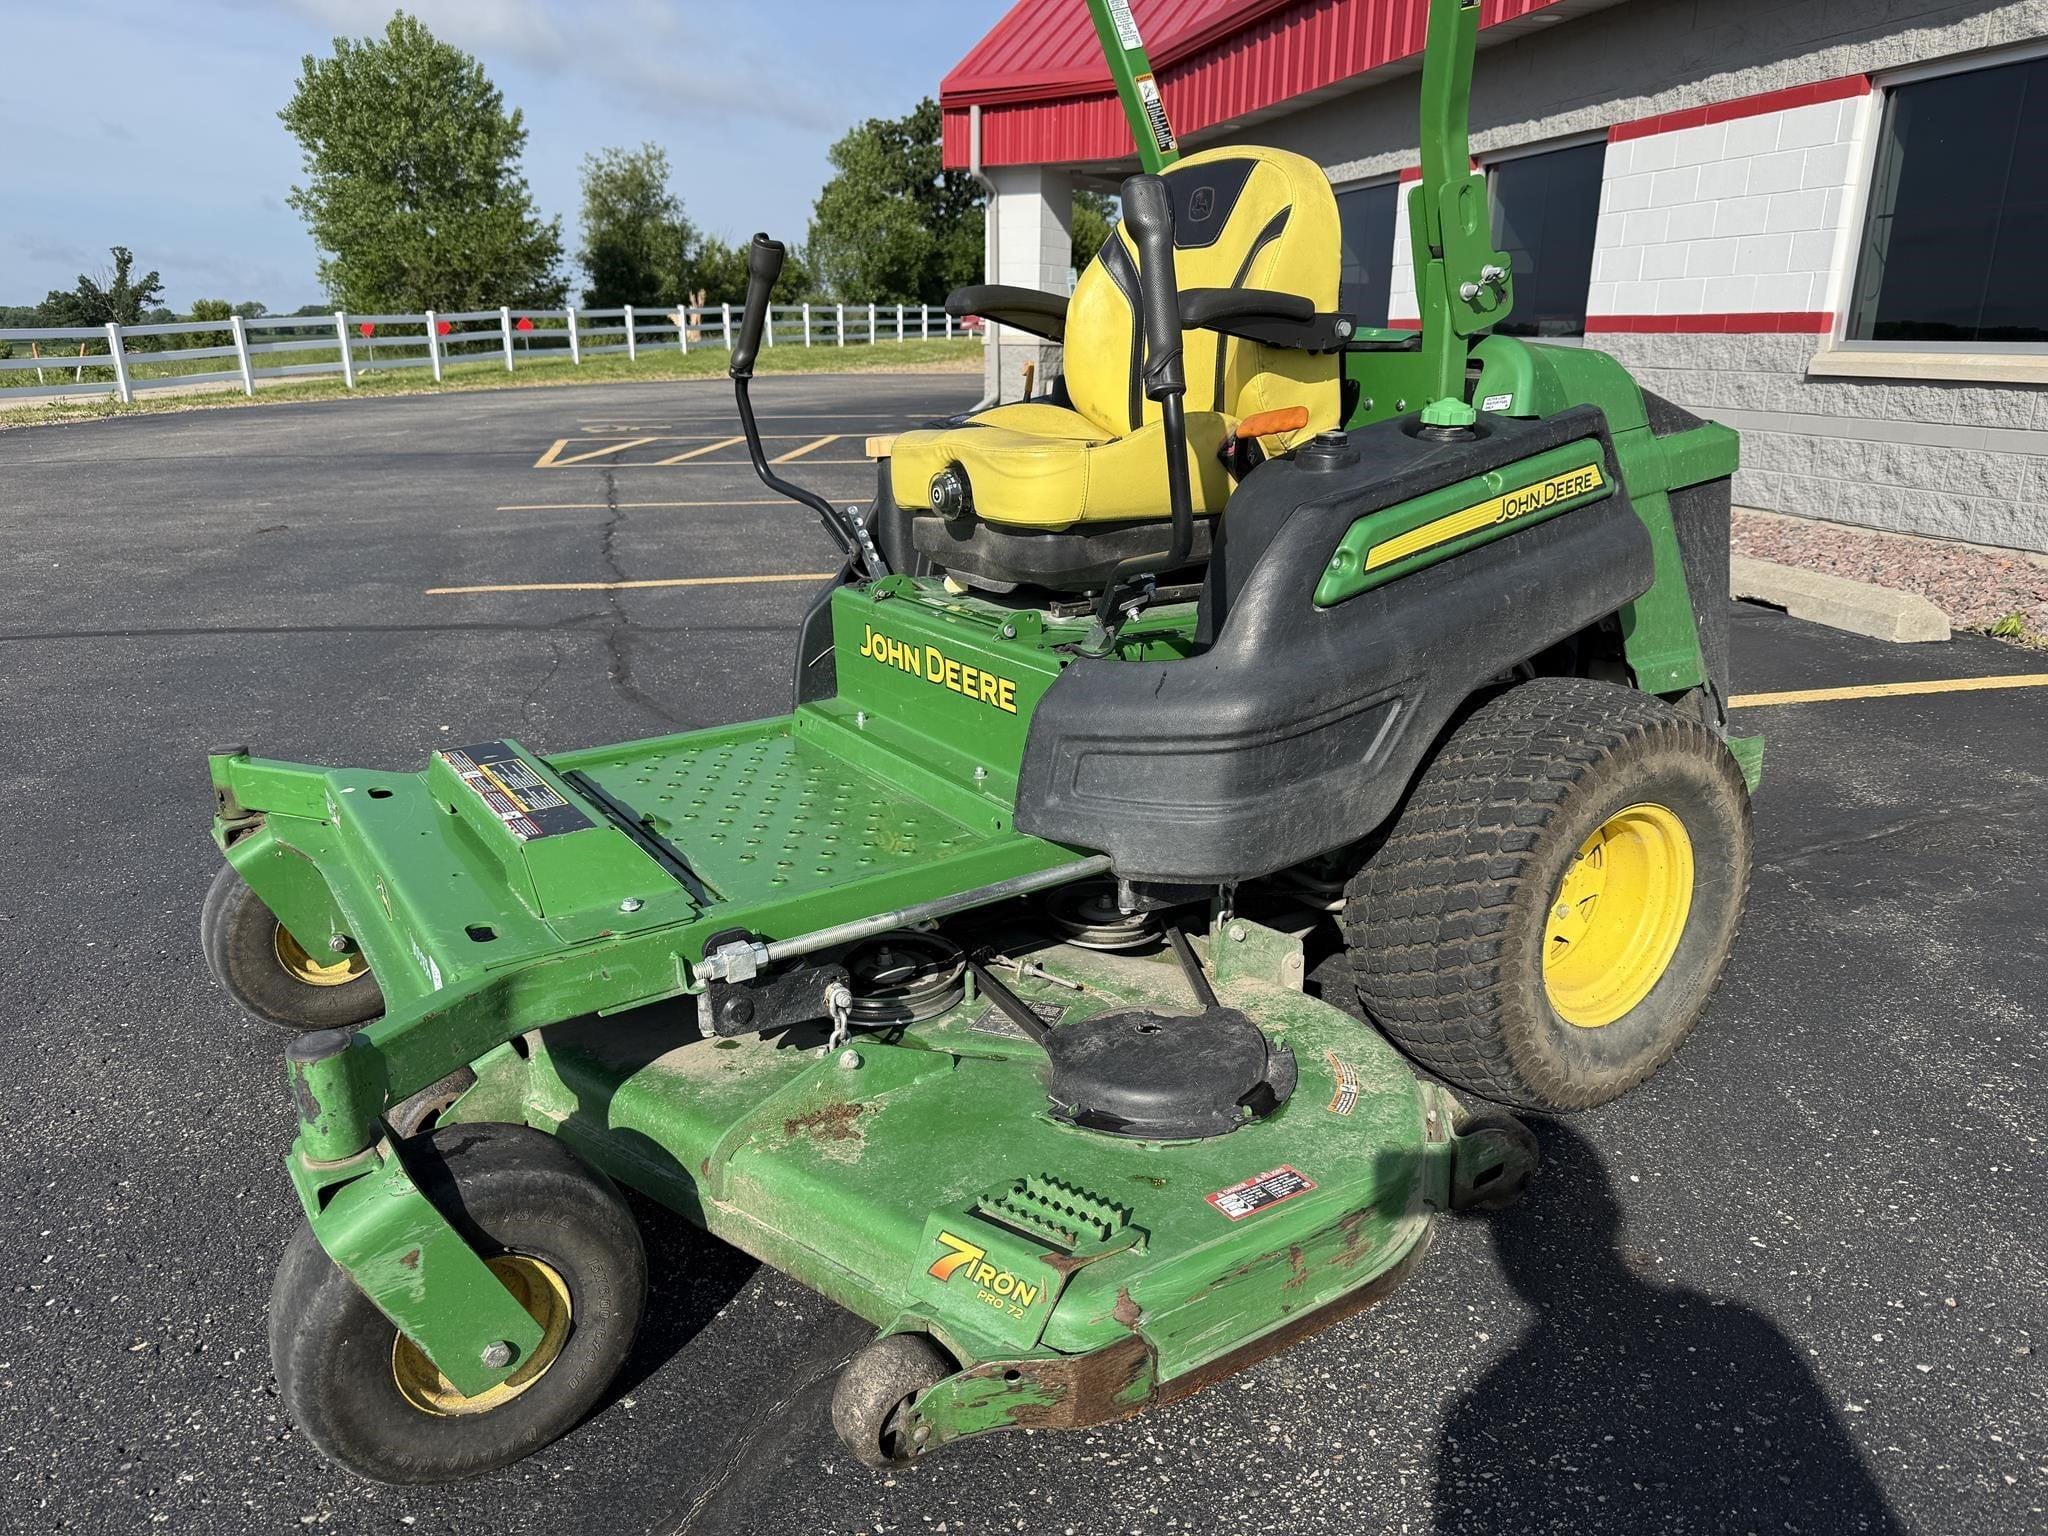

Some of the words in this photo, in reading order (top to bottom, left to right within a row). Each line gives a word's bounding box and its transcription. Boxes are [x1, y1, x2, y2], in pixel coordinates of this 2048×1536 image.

[1496, 489, 1541, 521] JOHN
[1544, 472, 1593, 502] DEERE
[860, 623, 921, 677] JOHN
[925, 644, 1018, 716] DEERE
[976, 1290, 1004, 1309] PRO
[1006, 1304, 1025, 1320] 72
